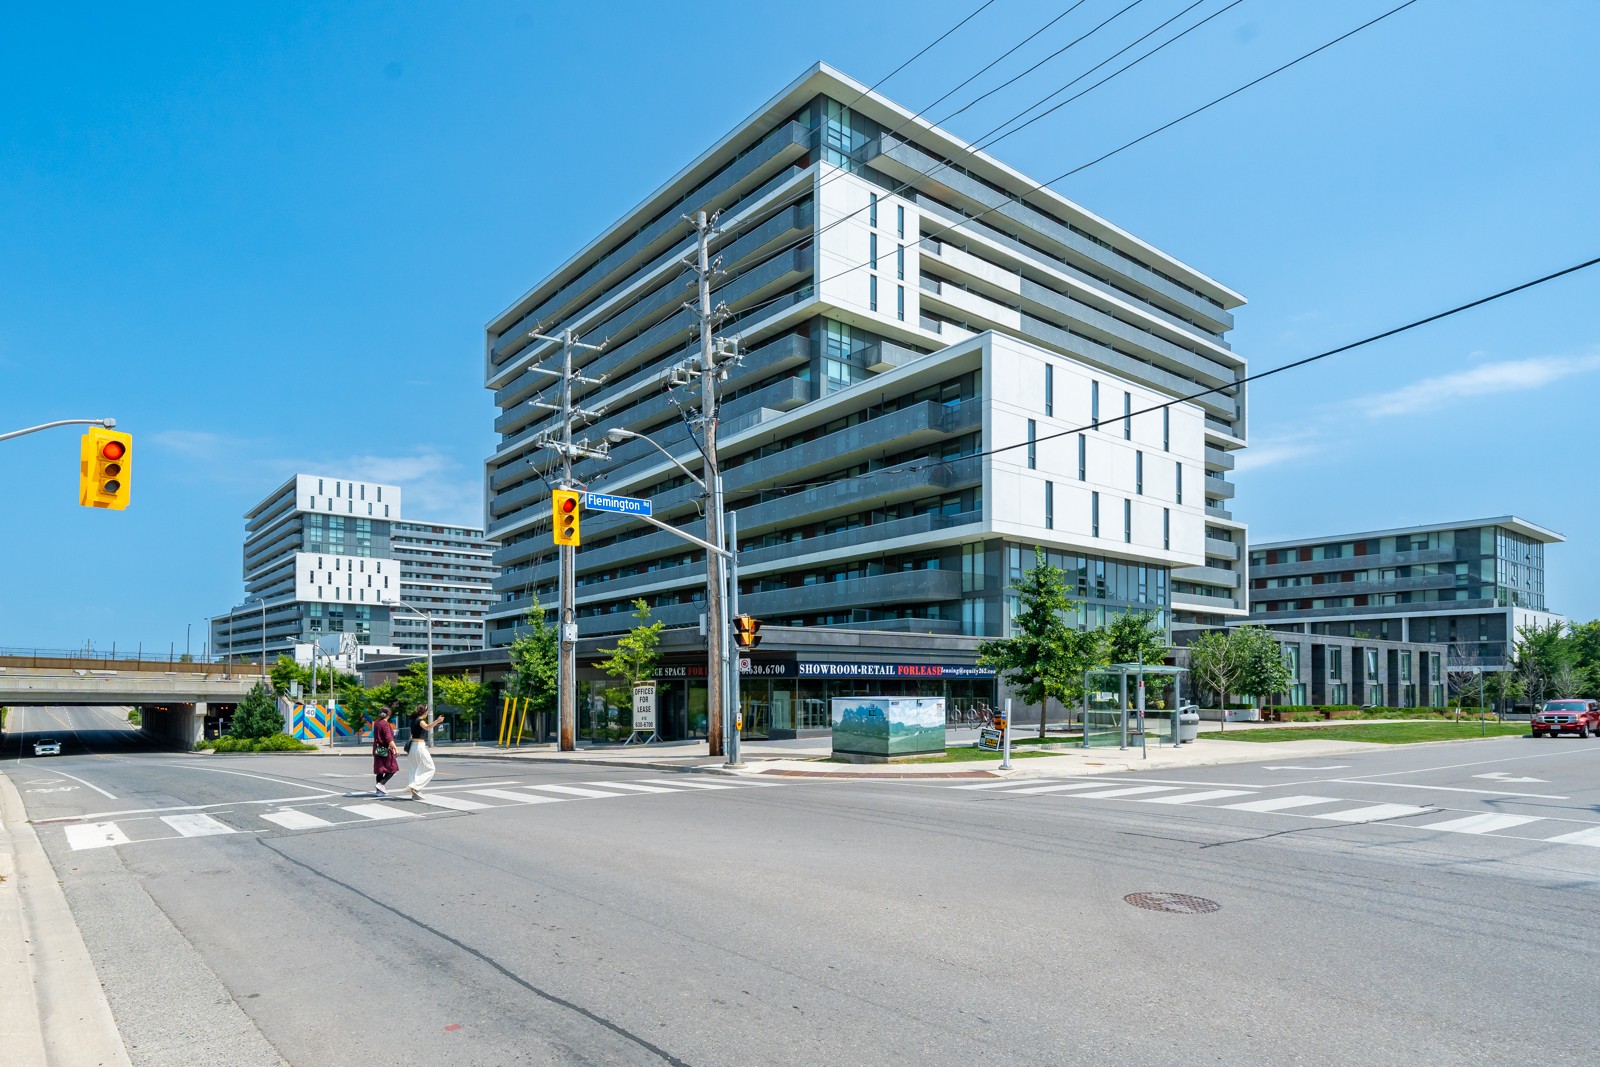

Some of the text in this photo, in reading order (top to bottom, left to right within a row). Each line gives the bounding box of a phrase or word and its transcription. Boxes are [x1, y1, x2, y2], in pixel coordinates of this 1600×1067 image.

[588, 494, 640, 511] Flemington
[664, 667, 686, 676] SPACE
[687, 667, 701, 676] FOR
[634, 687, 654, 695] OFFICES
[639, 695, 649, 703] FOR
[636, 705, 651, 713] LEASE
